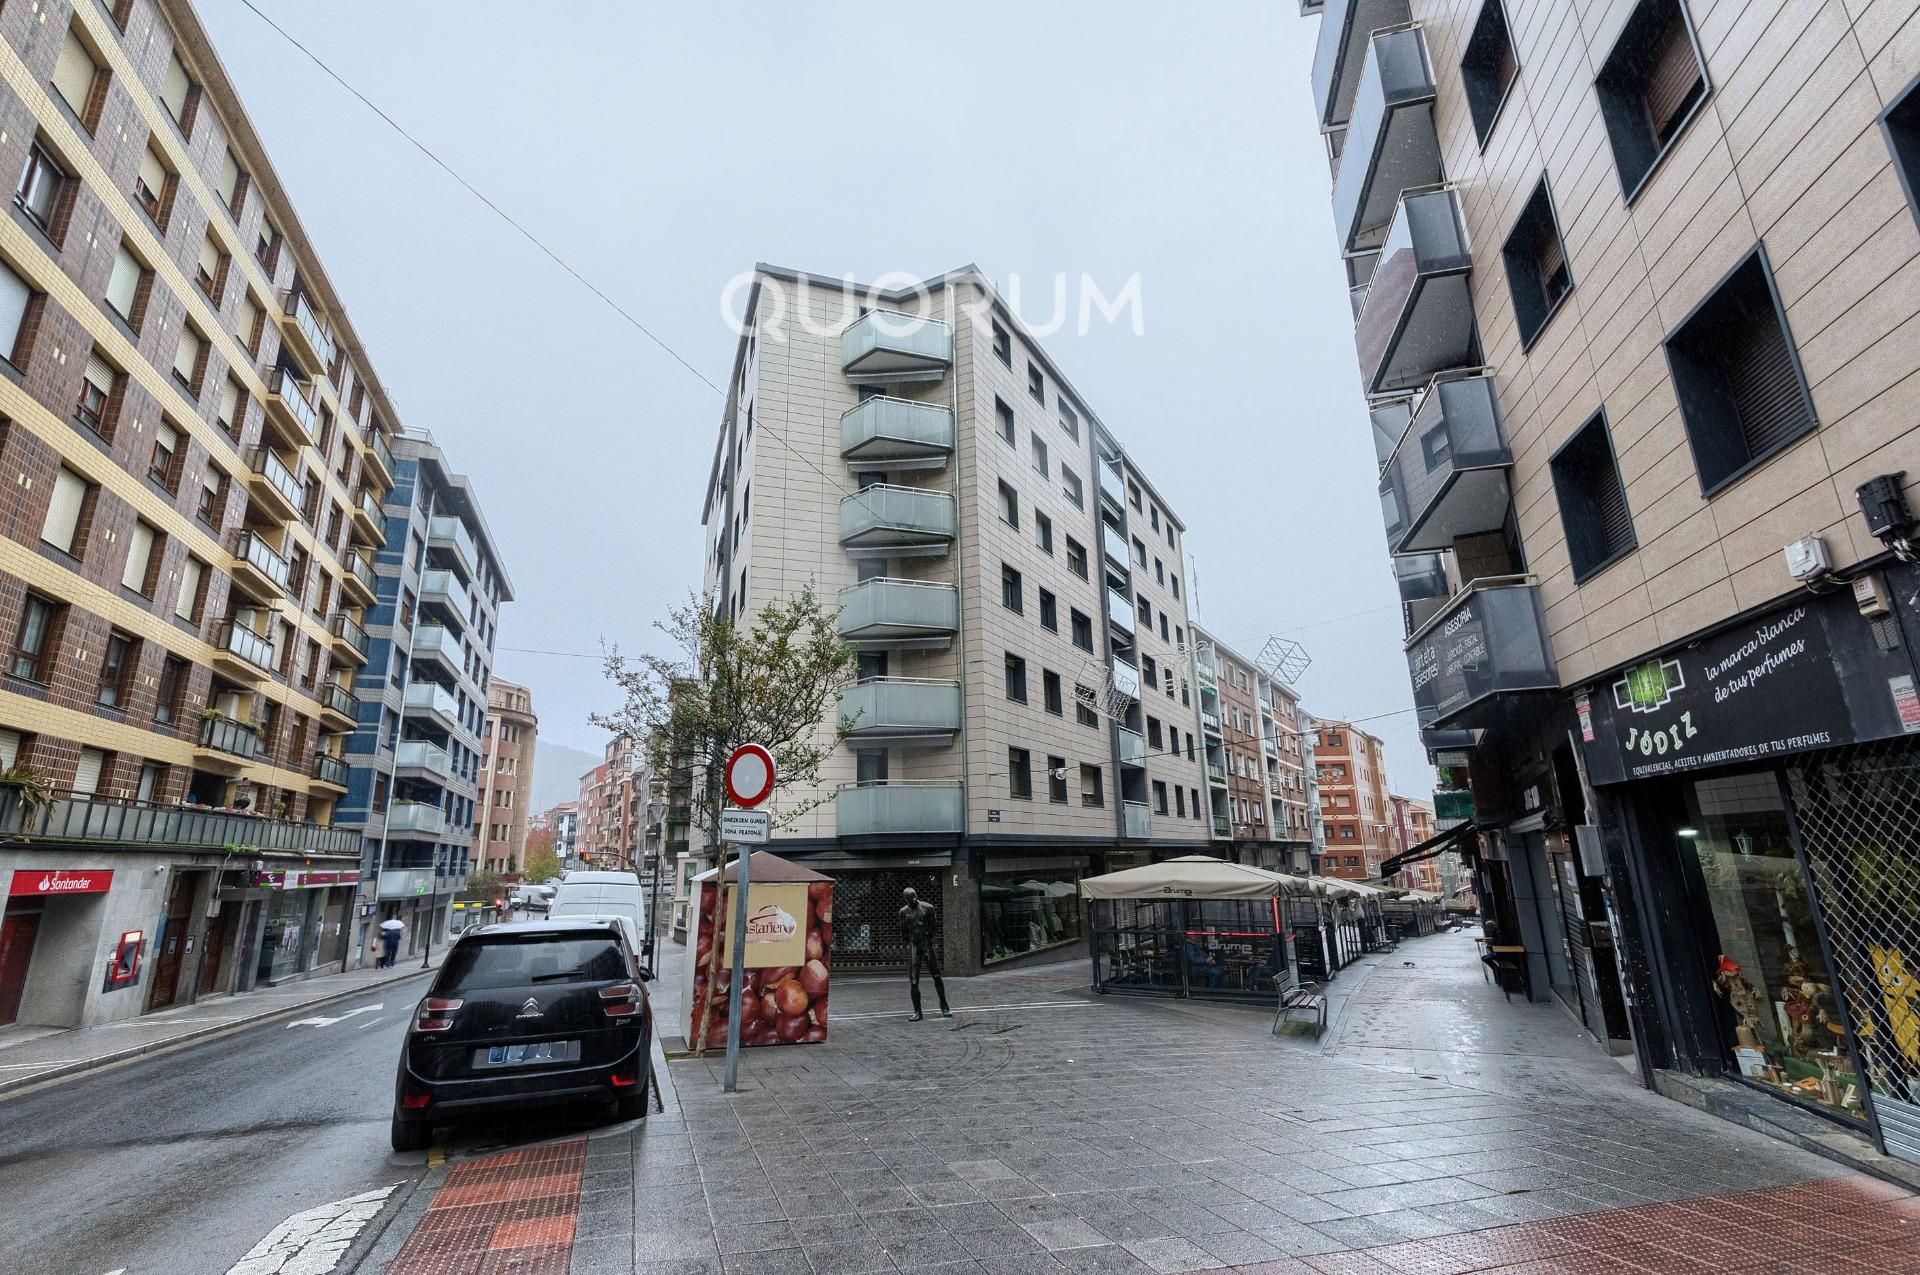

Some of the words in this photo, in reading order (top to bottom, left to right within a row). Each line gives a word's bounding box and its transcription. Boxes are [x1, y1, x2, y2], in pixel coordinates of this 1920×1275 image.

[1704, 667, 1720, 681] la
[1720, 639, 1758, 672] marca
[1756, 607, 1806, 645] blanca
[1414, 662, 1439, 689] asesores
[1714, 685, 1730, 703] de
[1729, 675, 1749, 693] tus
[1747, 639, 1805, 687] perfumes
[1625, 710, 1698, 756] JÓDIZ
[1633, 761, 1675, 776] EQUIVALENCIAS,
[1674, 756, 1697, 768] ACEITES
[1702, 745, 1758, 764] AMBIENTADORES
[1758, 743, 1769, 754] DE
[1770, 739, 1786, 752] TUS
[1786, 731, 1831, 749] PERFUMES
[738, 829, 763, 837] PEATONAL
[50, 877, 91, 890] Santander
